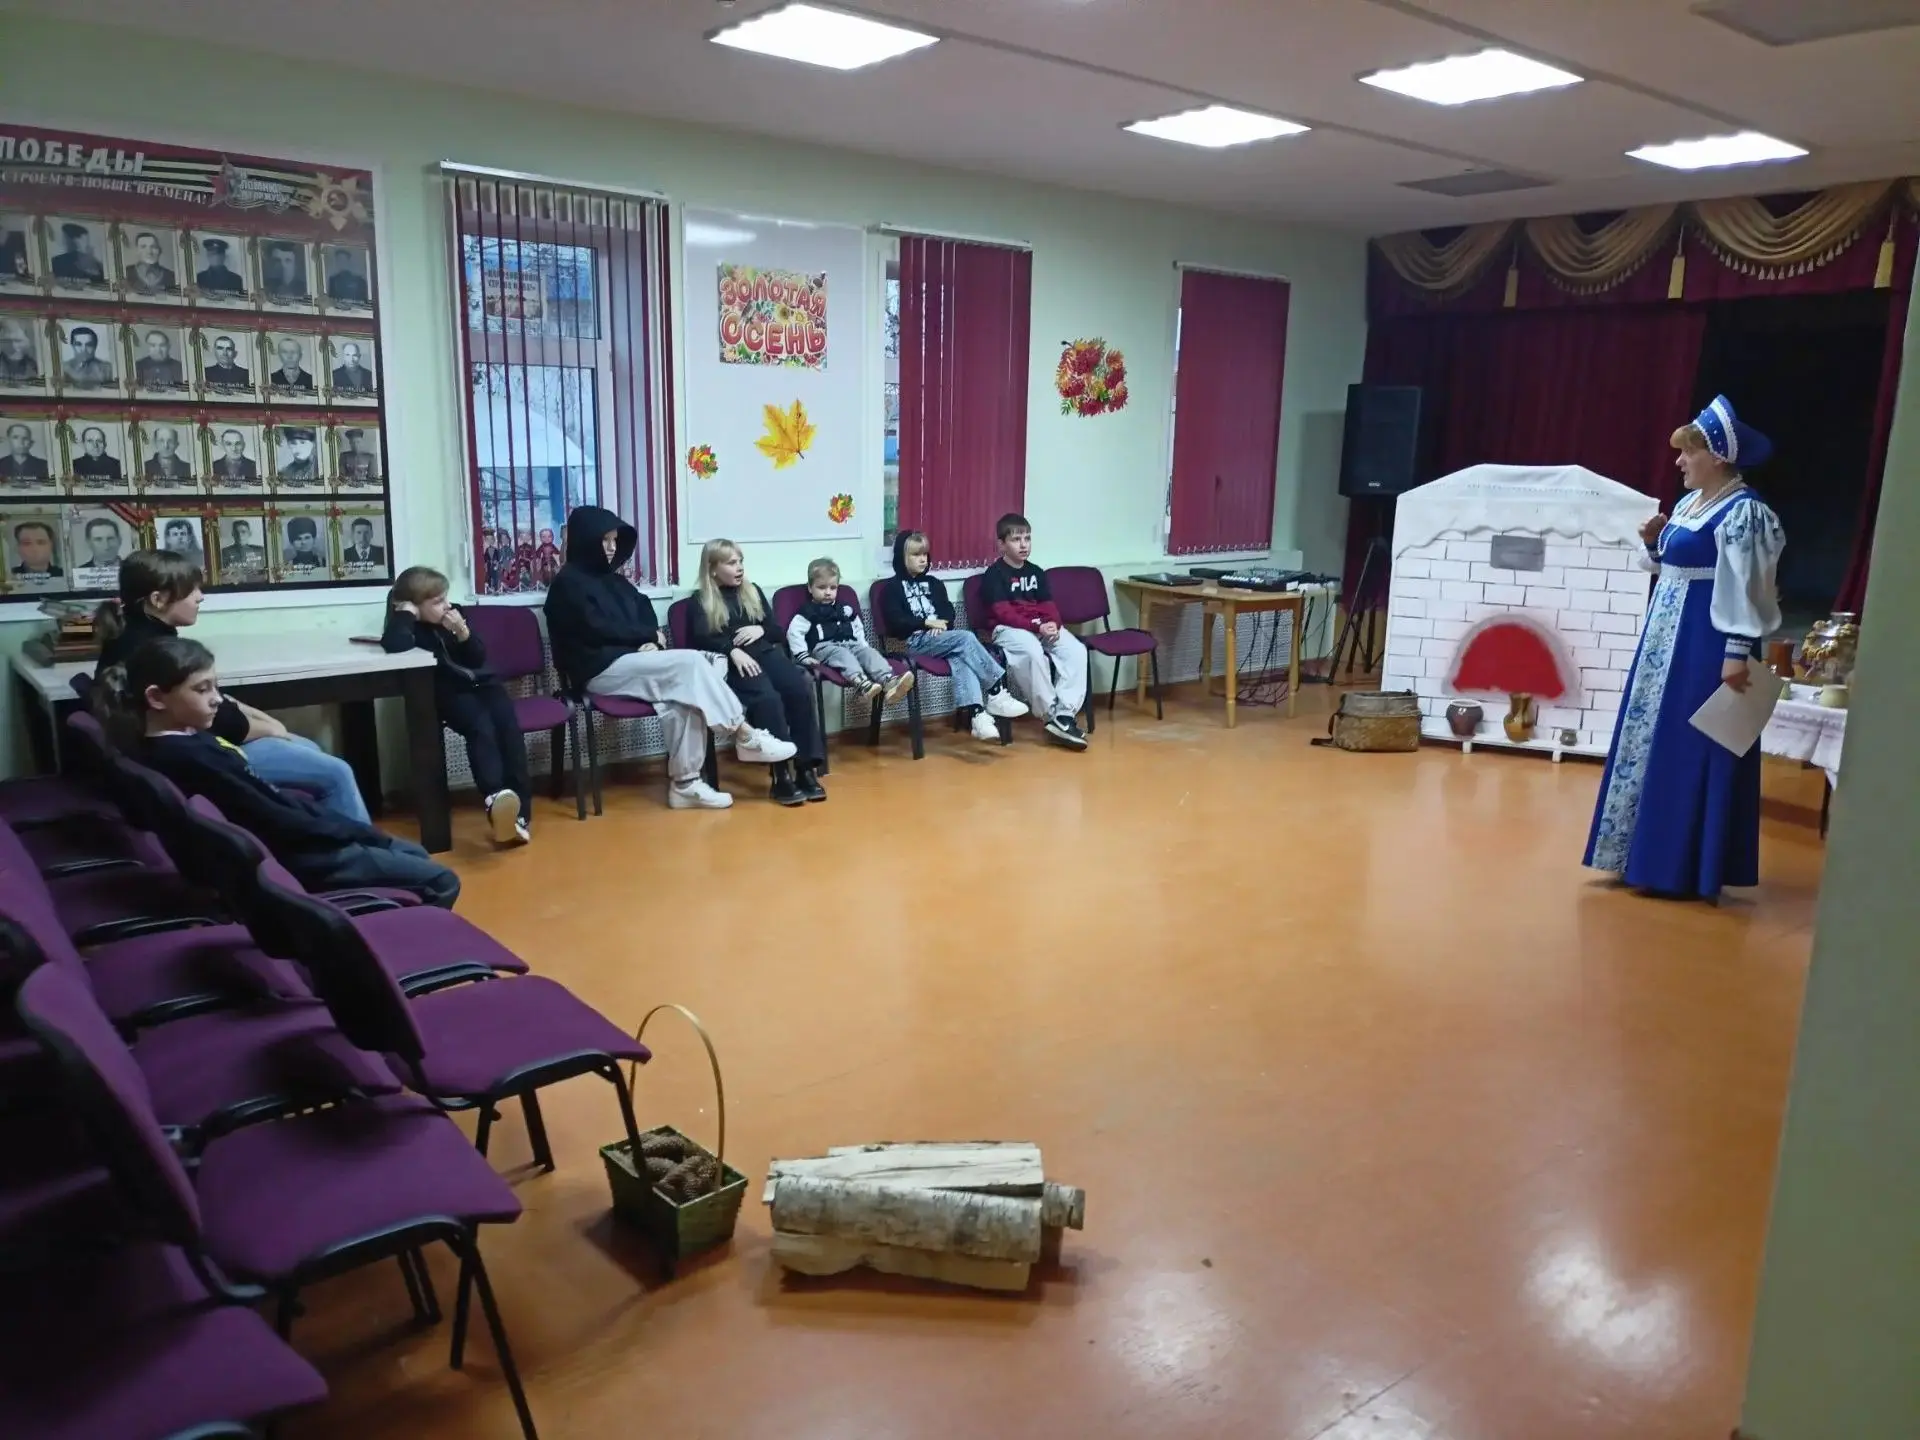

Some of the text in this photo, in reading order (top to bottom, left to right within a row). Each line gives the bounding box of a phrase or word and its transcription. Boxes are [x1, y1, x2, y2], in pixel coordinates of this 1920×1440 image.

[0, 136, 145, 175] ПОБЕДЫ
[137, 181, 208, 205] ВРЕМЕНА!
[720, 274, 827, 318] ЗОЛОТАЯ
[721, 312, 826, 355] ОСЕНЬ
[1008, 573, 1038, 593] FILA
